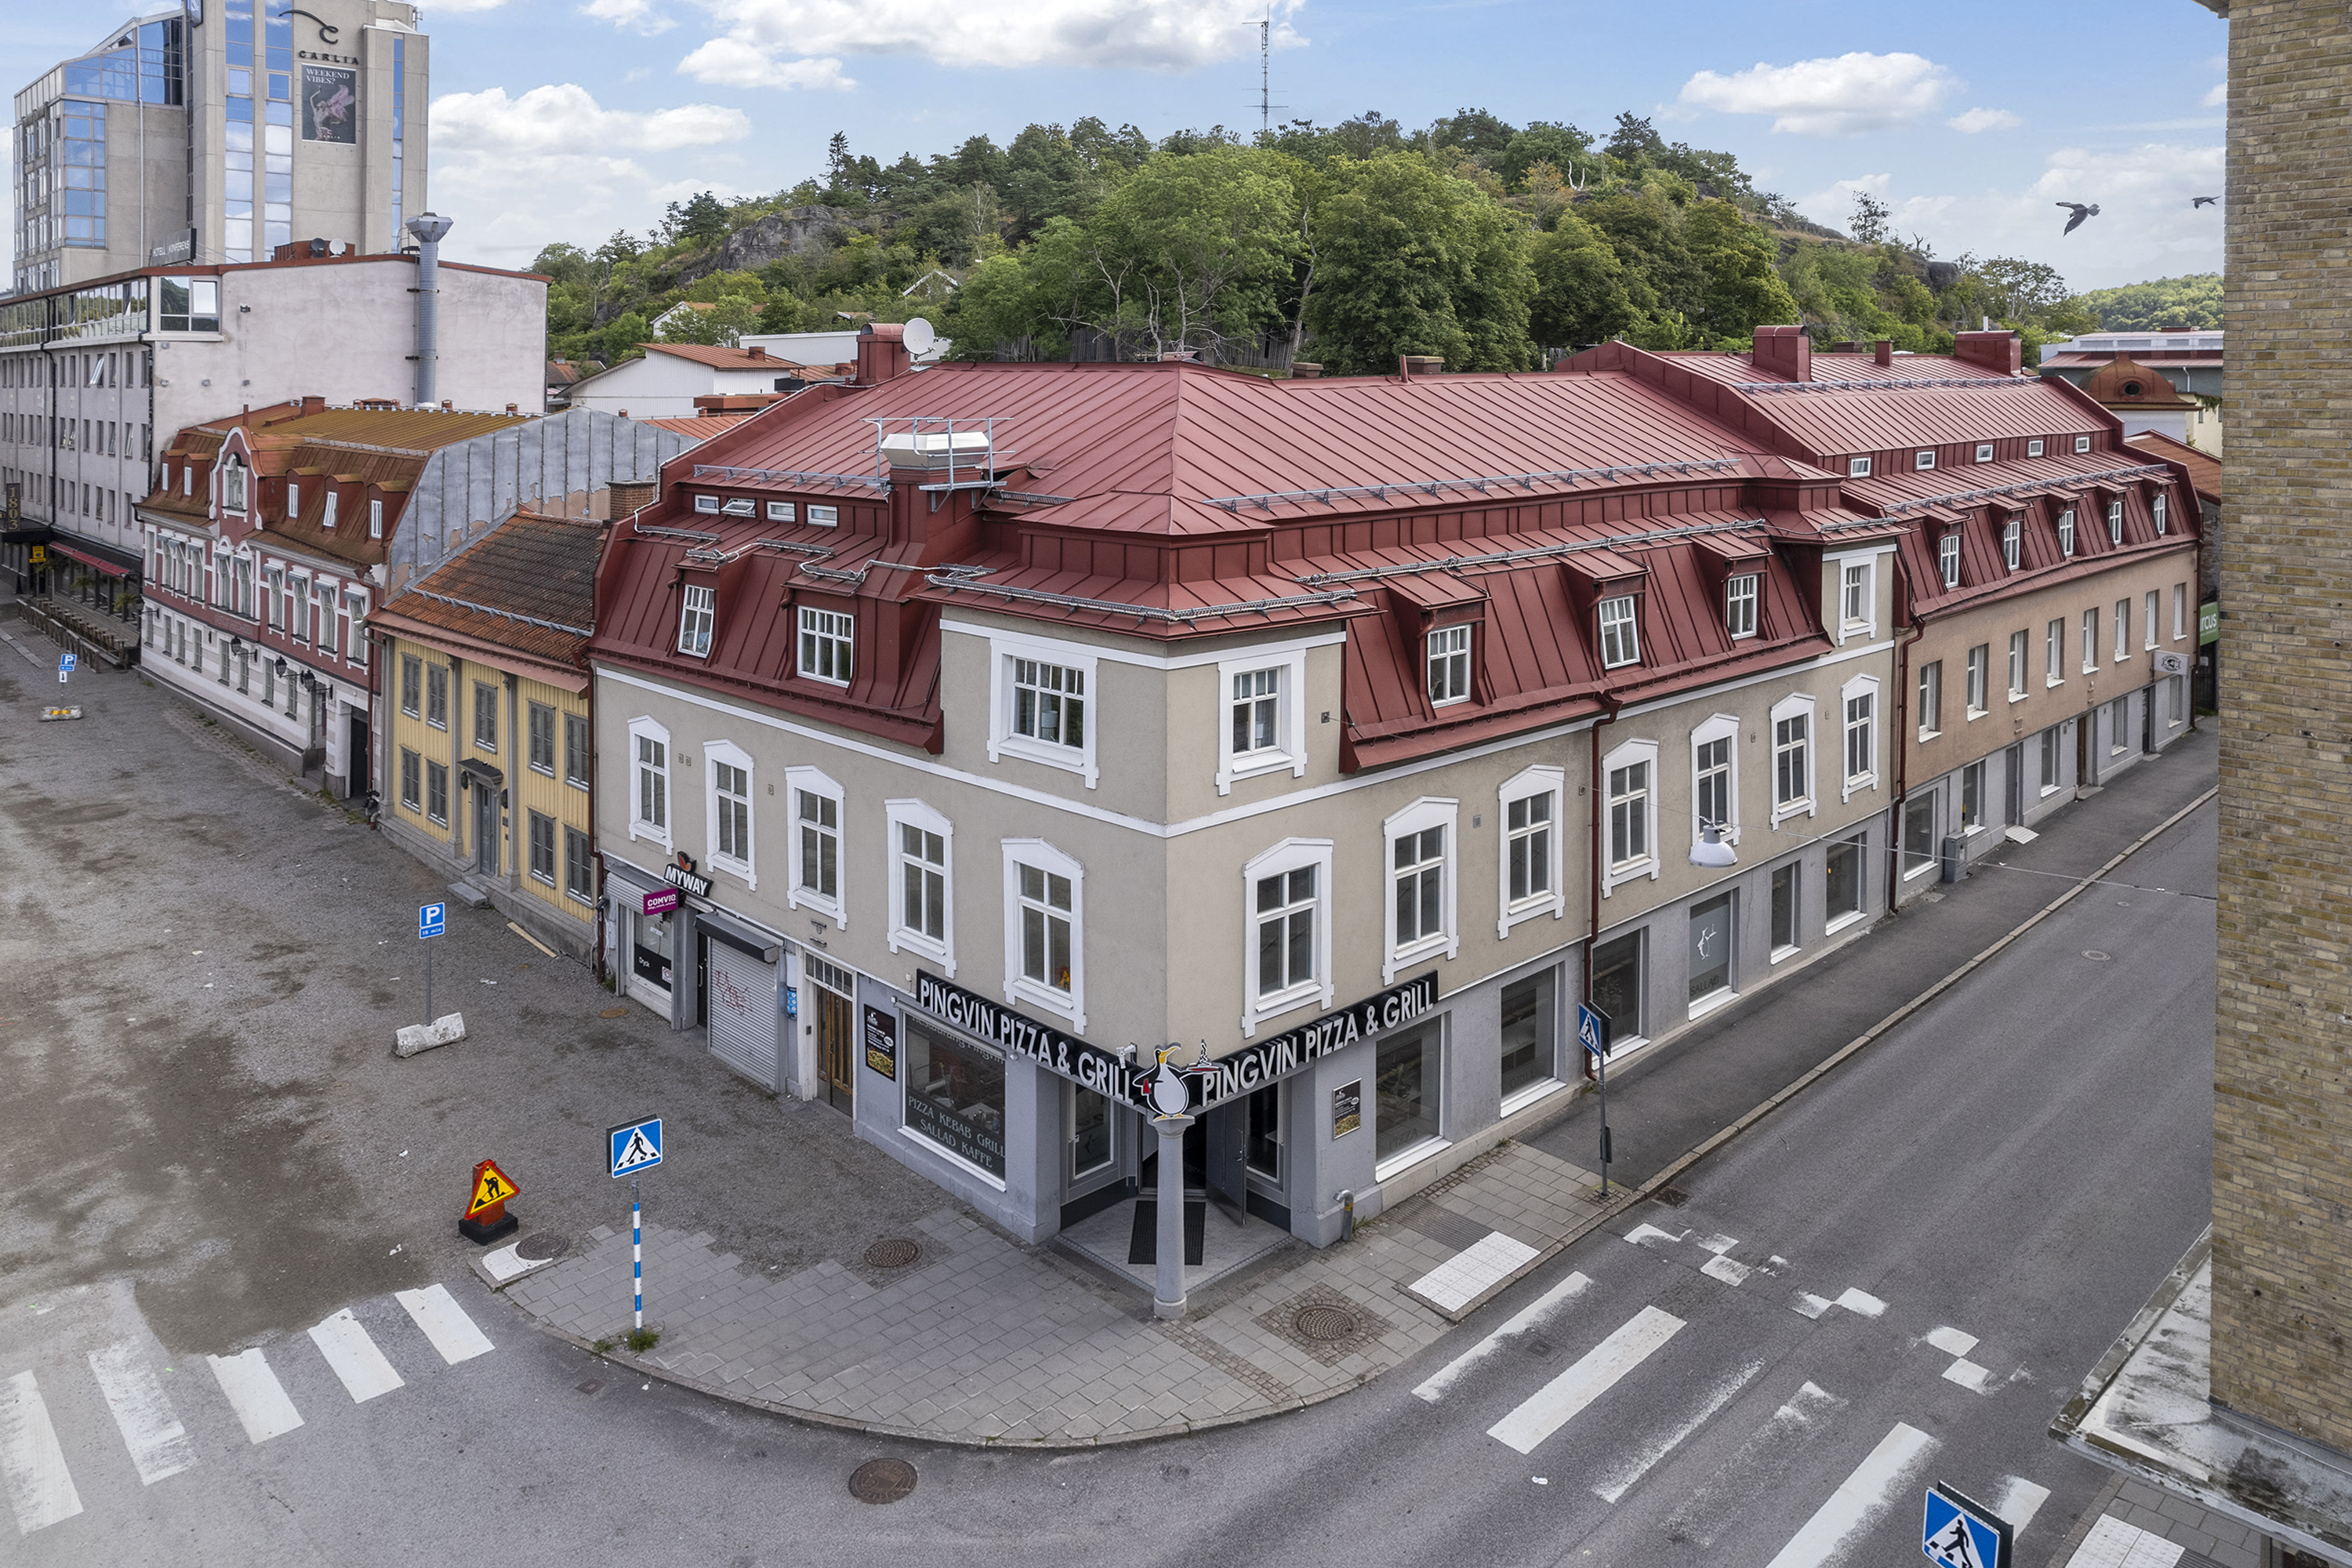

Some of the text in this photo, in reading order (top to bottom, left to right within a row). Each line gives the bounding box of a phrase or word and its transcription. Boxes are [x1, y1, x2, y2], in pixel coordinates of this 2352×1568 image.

[299, 50, 358, 64] CARLIA
[307, 68, 350, 79] WEEKEND
[307, 75, 336, 84] VIBES?
[9, 487, 18, 530] 1803
[65, 655, 74, 664] P
[666, 866, 708, 896] MYWAY
[648, 894, 677, 907] COMVIQ
[426, 906, 440, 924] P
[1690, 975, 1719, 996] SALLAD
[920, 978, 994, 1040] PINGVIN
[1001, 1014, 1053, 1068] PIZZA
[1058, 1041, 1072, 1075] &
[1078, 1052, 1134, 1106] GRILL
[1203, 981, 1433, 1107] PINGVIN PIZZA & GRILL
[909, 1096, 1005, 1158] PIZZA KEBAB GRILL
[920, 1119, 993, 1168] SALLAD KAFFE
